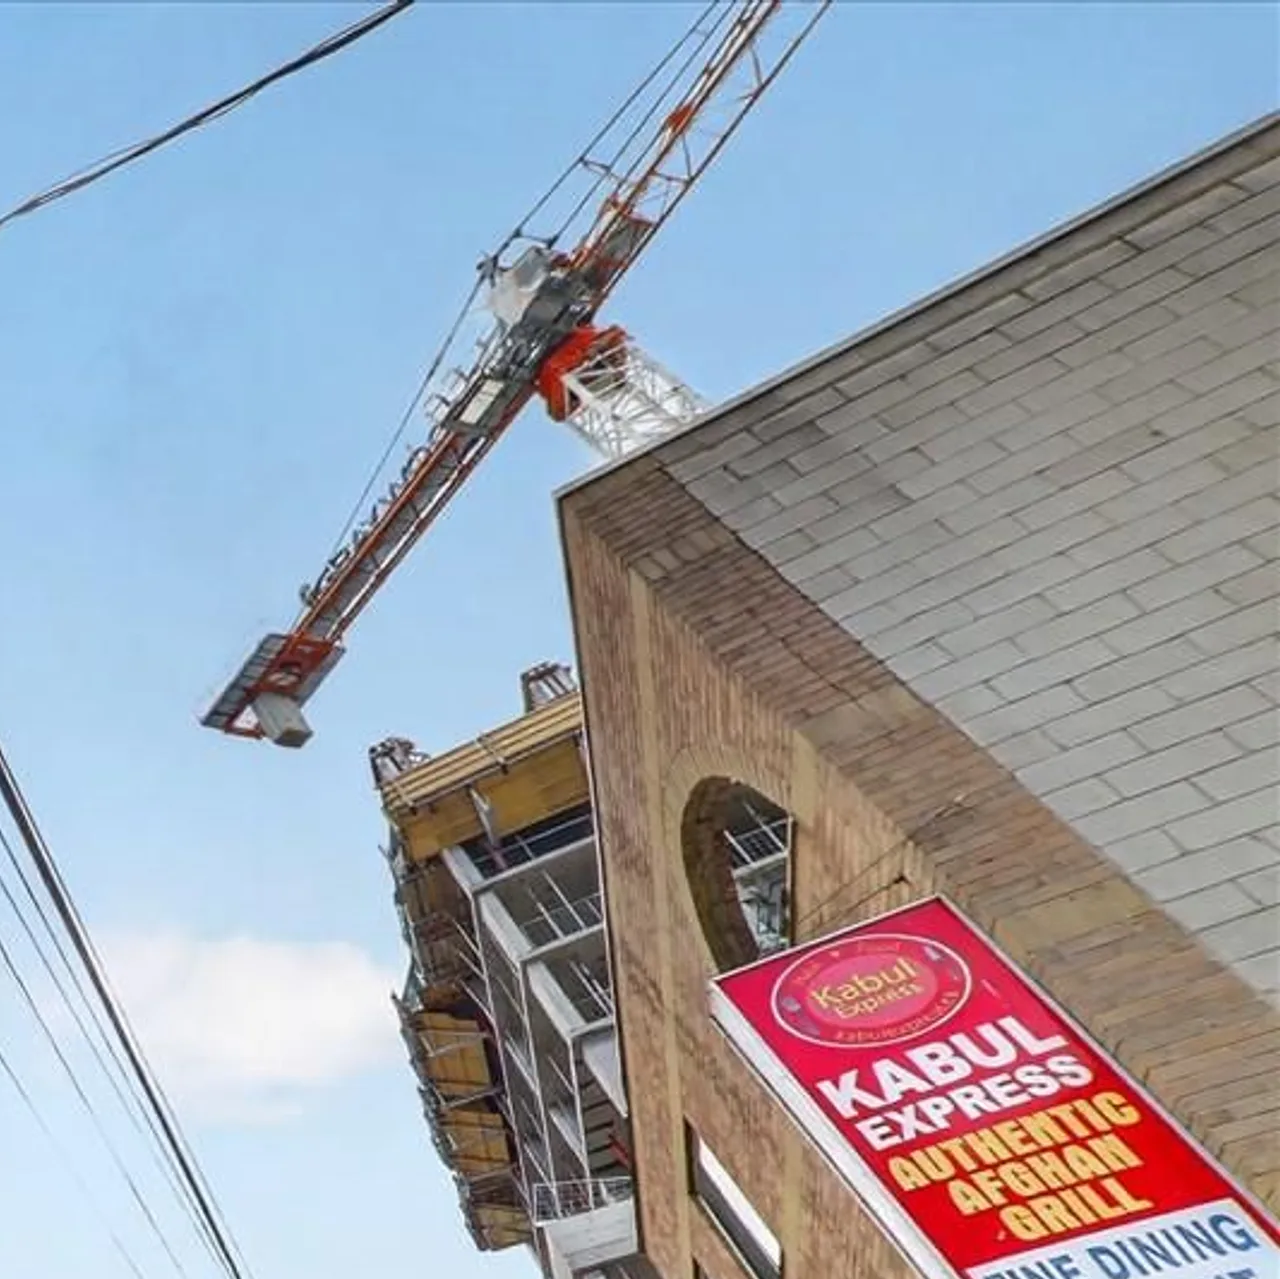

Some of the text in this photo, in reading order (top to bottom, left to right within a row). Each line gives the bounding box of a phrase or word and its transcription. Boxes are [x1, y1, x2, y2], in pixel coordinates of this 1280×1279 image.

[810, 957, 918, 1008] Kabul
[832, 981, 926, 1019] Express
[815, 1015, 1069, 1119] KABUL
[855, 1055, 1093, 1151] EXPRESS
[889, 1091, 1140, 1191] AUTHENTIC
[948, 1133, 1144, 1216] AFGHAN
[1000, 1177, 1154, 1241] GRILL
